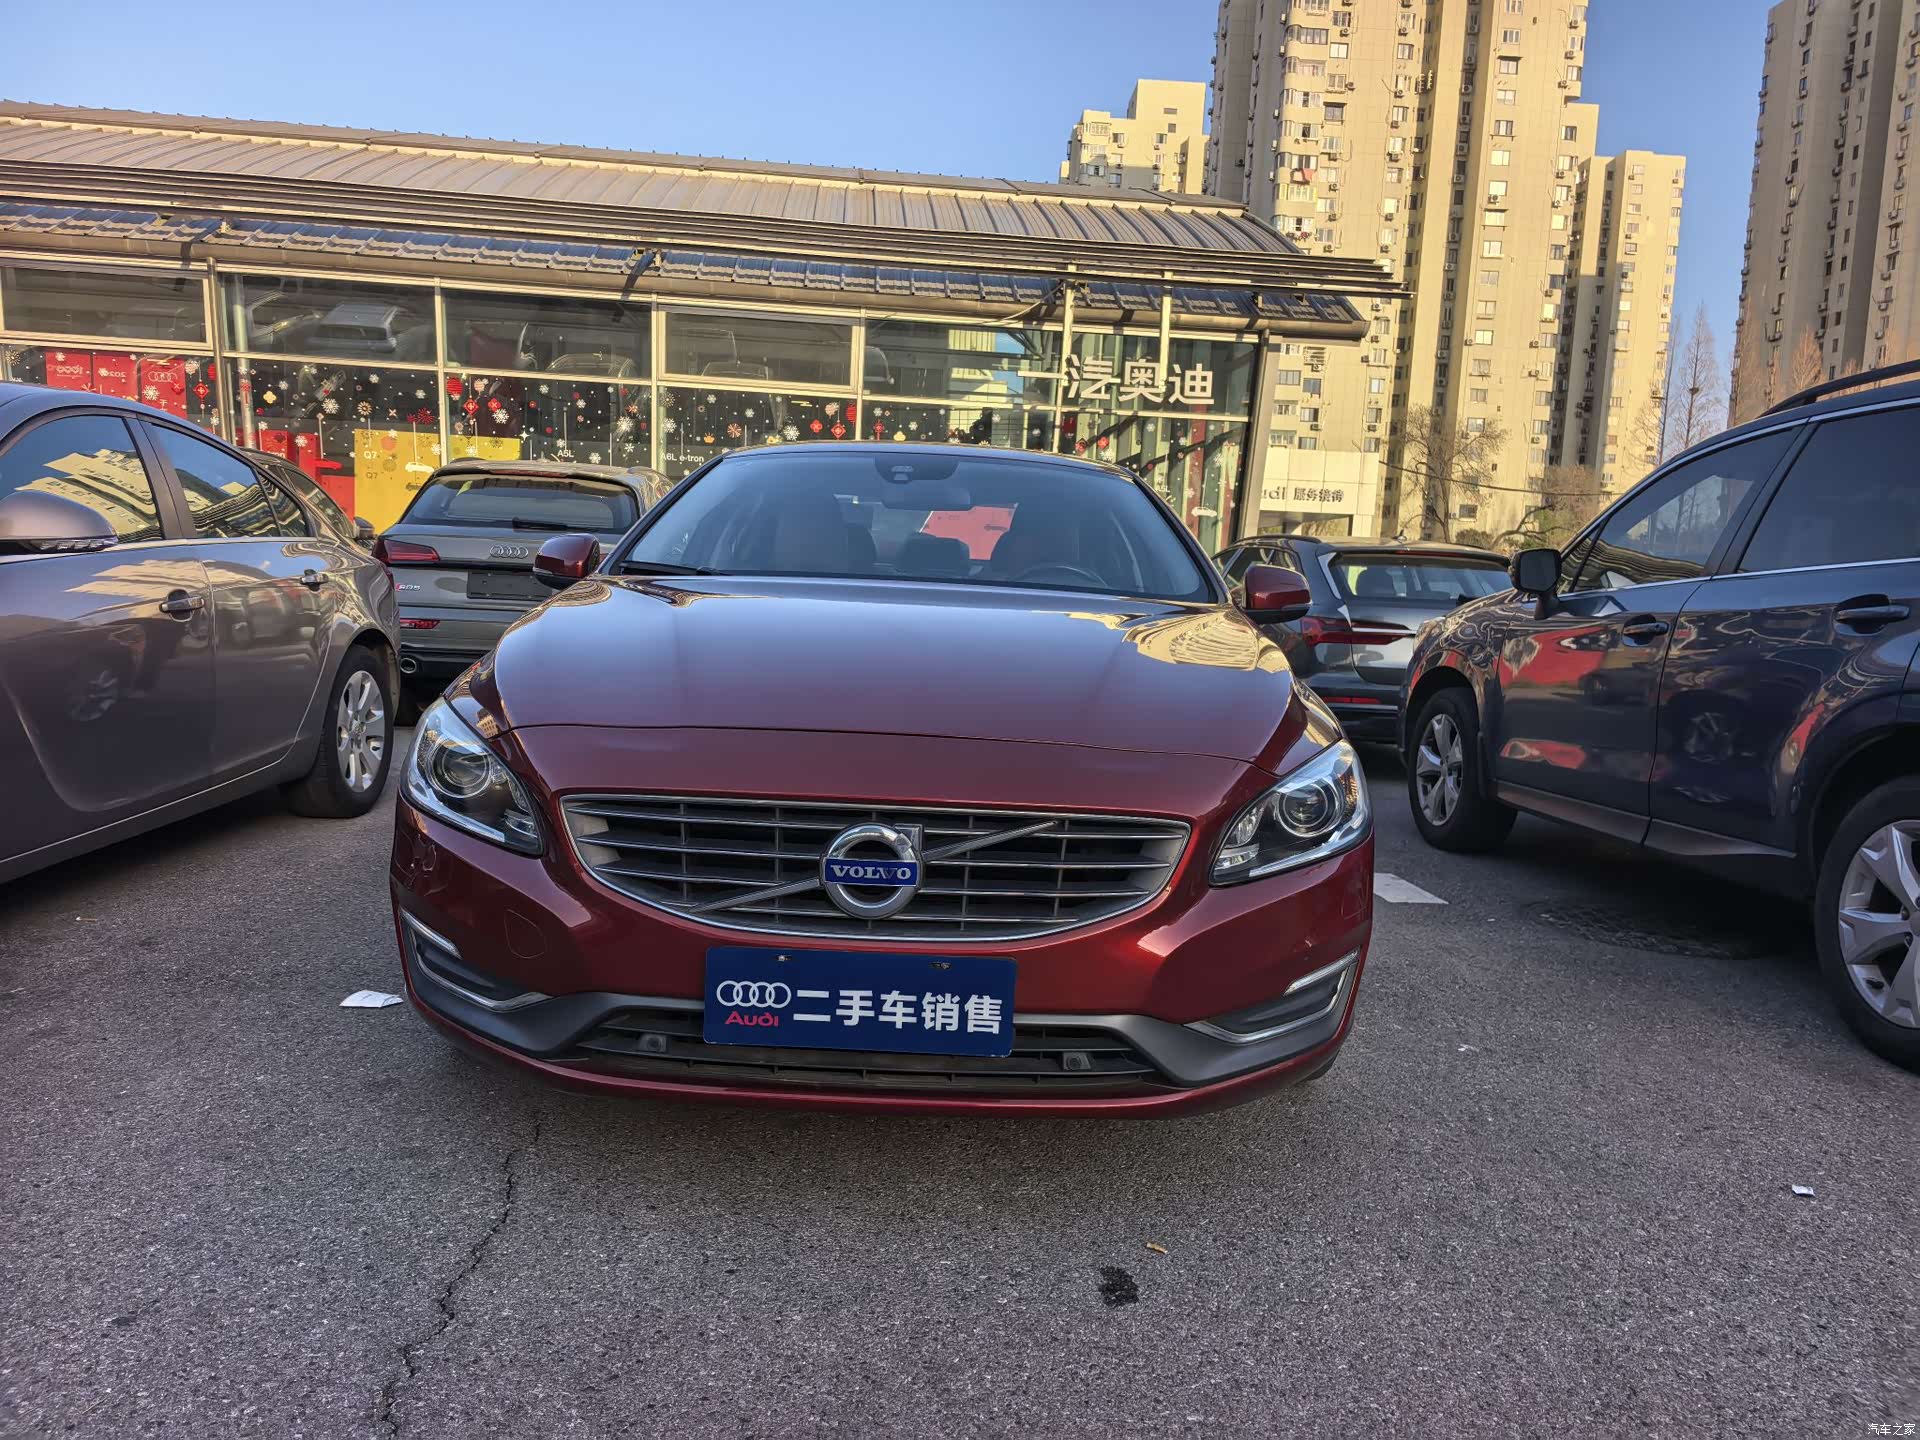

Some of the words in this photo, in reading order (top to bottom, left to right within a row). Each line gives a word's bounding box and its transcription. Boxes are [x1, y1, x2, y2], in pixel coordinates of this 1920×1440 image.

[363, 450, 378, 460] Q7
[557, 449, 575, 459] A5L
[830, 864, 912, 880] VOLVO
[724, 1010, 779, 1028] Audi
[793, 989, 1004, 1035] 二手车销售
